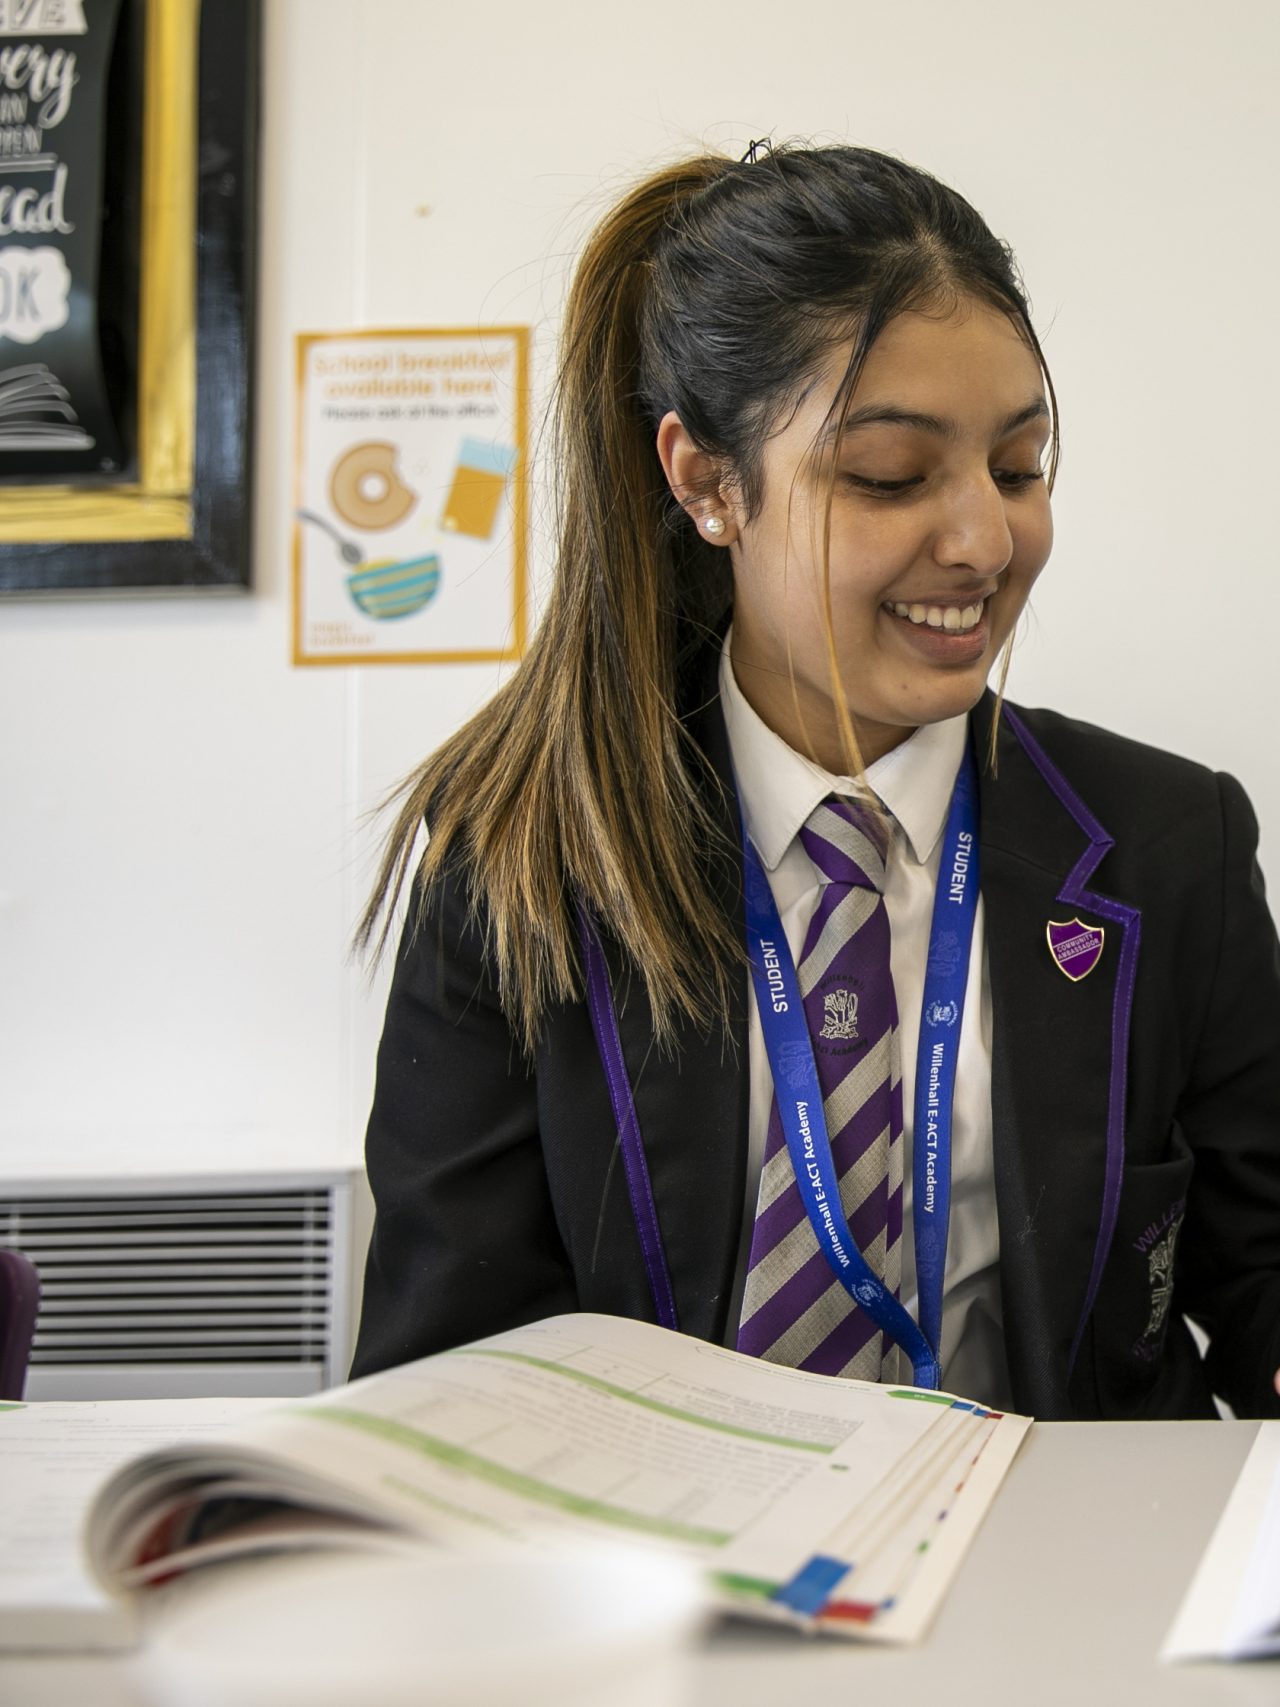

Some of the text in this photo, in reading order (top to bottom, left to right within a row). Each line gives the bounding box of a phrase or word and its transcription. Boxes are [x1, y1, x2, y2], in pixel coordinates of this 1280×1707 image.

[949, 832, 972, 904] STUDENT
[760, 939, 788, 1013] STUDENT
[1056, 934, 1093, 952] COMMUNITY
[1058, 938, 1100, 960] AMBASSADOR
[924, 1043, 944, 1213] Willenhall E-ACT Academy
[796, 1101, 850, 1268] Willenhall E-ACT Academy
